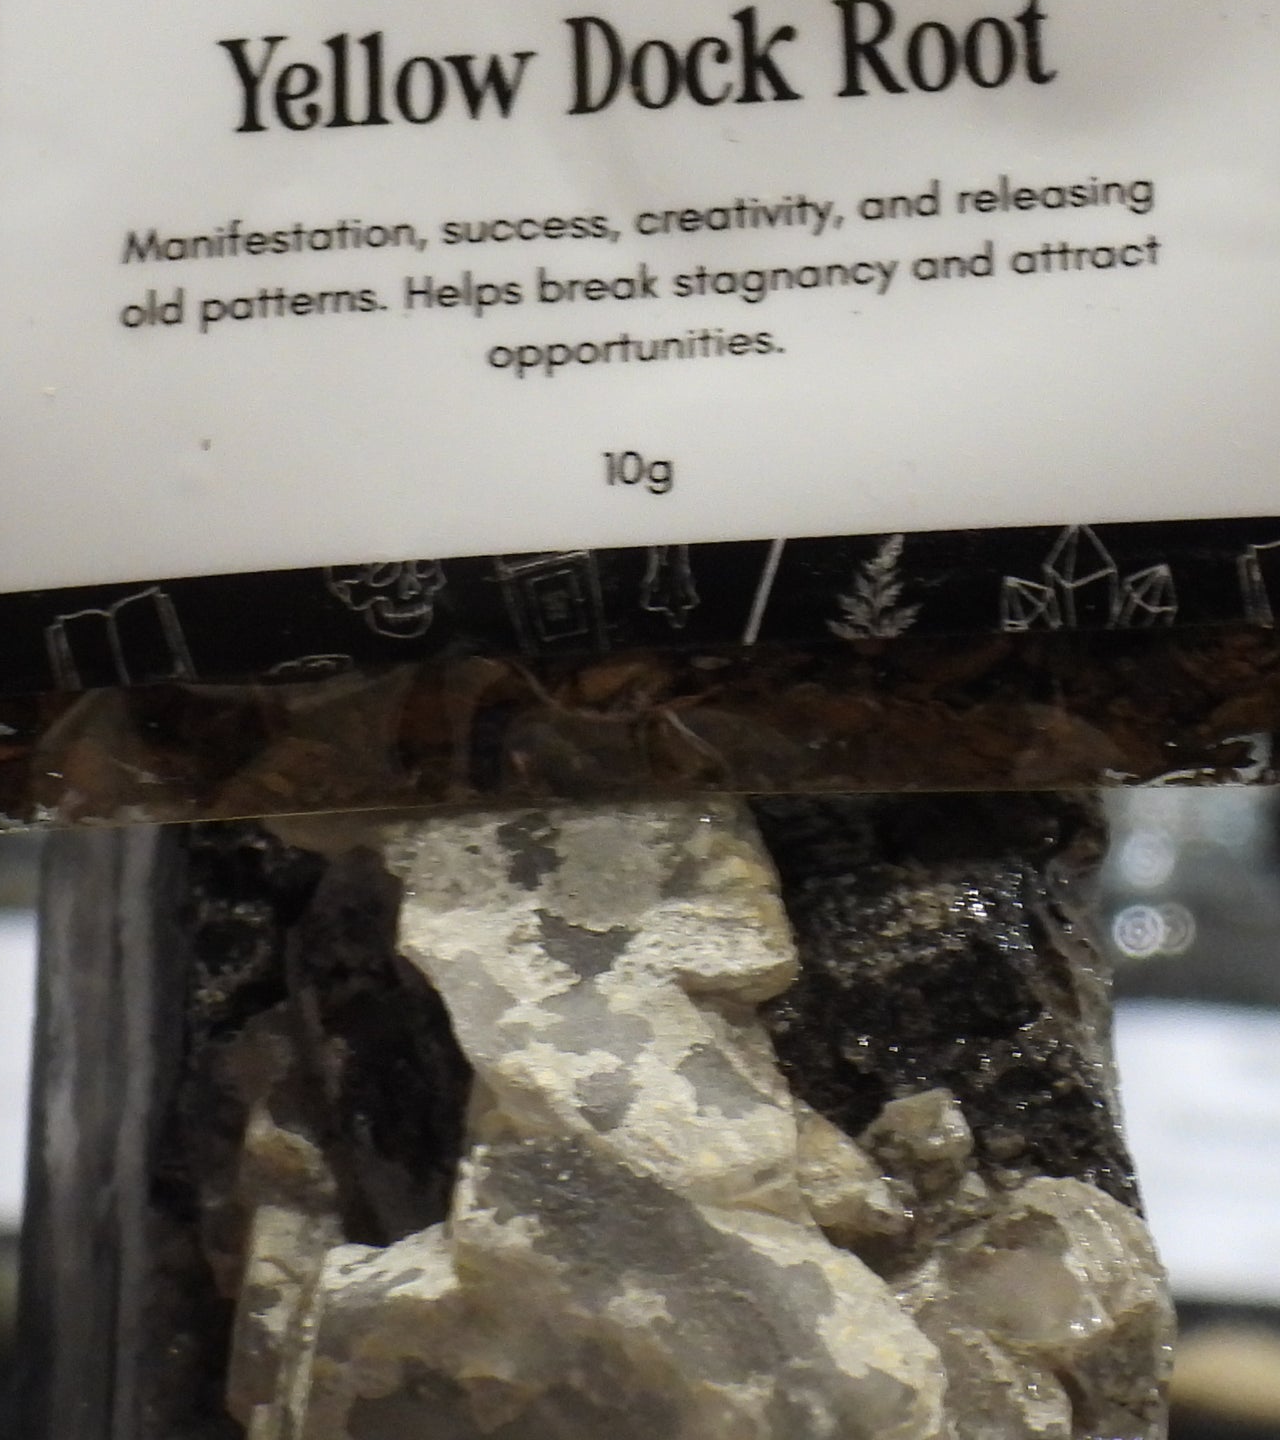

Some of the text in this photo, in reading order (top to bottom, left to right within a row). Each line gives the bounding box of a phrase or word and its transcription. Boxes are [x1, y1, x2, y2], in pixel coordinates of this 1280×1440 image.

[216, 31, 537, 133] Yellow
[563, 6, 804, 115] Dock
[122, 174, 1155, 265] Manifestation, success, creativity, and releasing
[119, 235, 1162, 334] old patterns. Helps break stagnancy and attract
[487, 328, 785, 380] opportunities.
[602, 450, 674, 496] 10g
